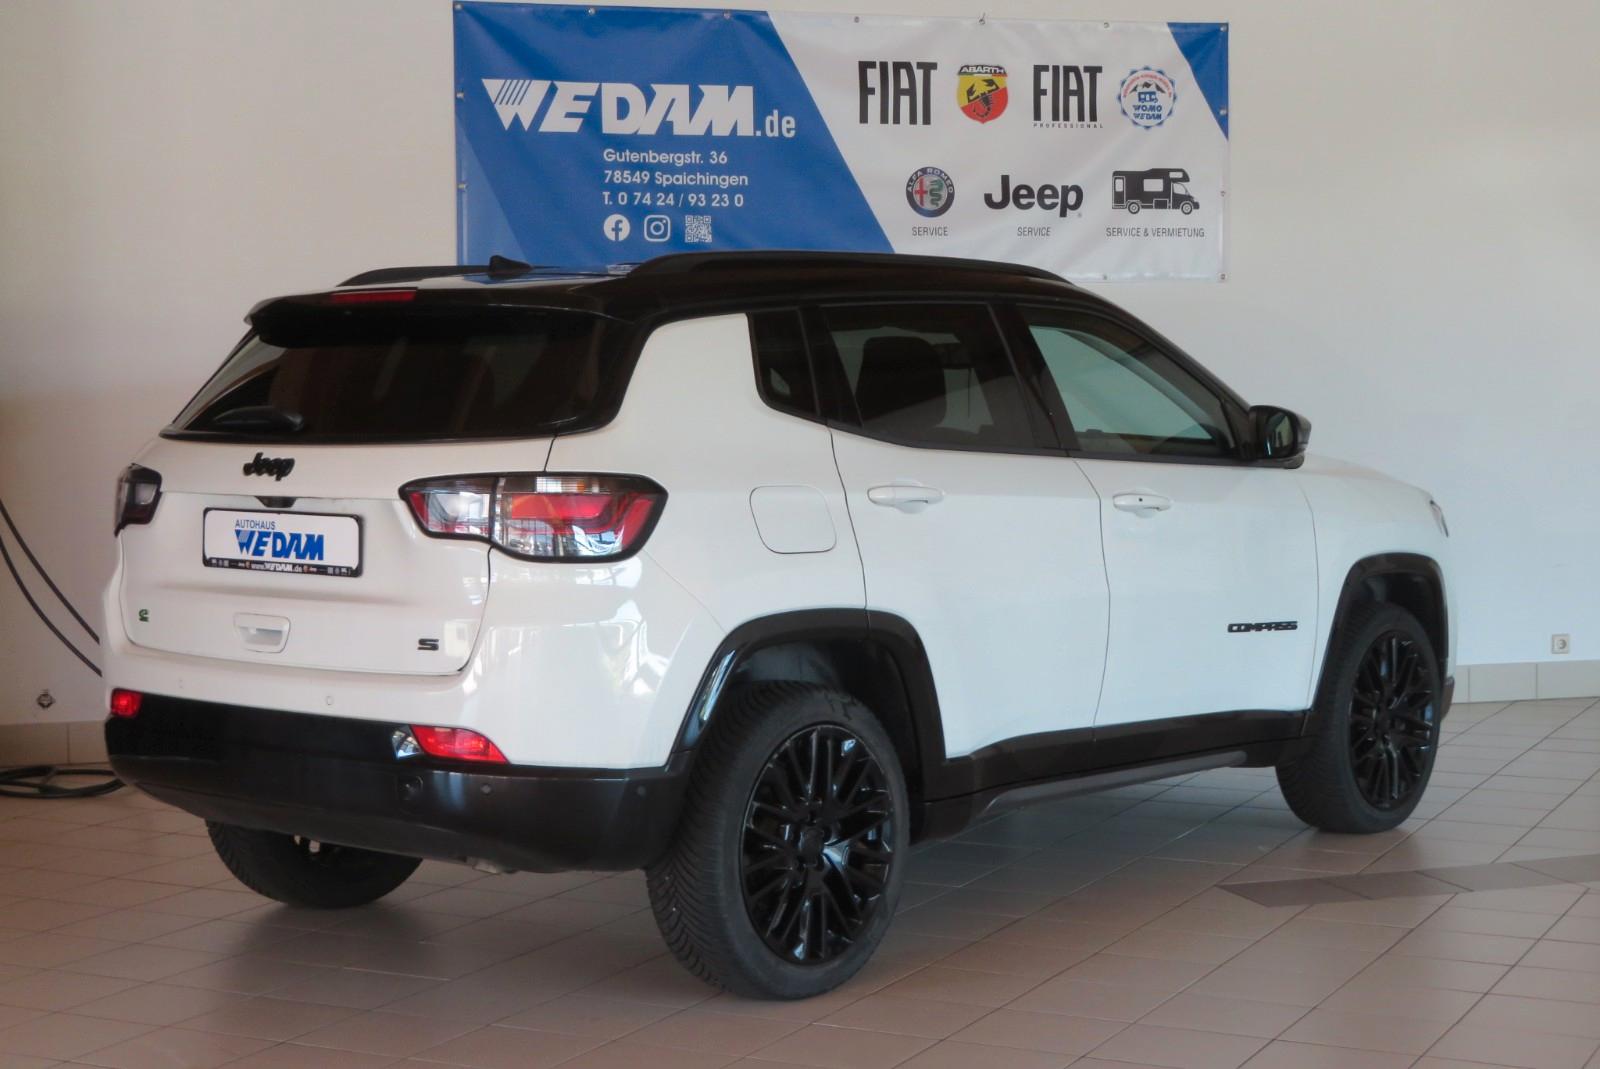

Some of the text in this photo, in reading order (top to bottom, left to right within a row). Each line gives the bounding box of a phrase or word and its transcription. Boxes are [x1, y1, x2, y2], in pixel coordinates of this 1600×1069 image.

[858, 61, 937, 125] FIAT
[1033, 65, 1102, 122] FIAT
[1133, 104, 1162, 112] WOMO
[603, 148, 728, 167] Gutenbergstr. 36
[604, 170, 749, 188] 78549 Spaichingen
[907, 168, 954, 193] ALFA ROMEO
[603, 191, 613, 205] T.
[618, 191, 628, 206] 0
[633, 192, 652, 206] 74
[656, 192, 675, 206] 24
[688, 193, 707, 207] 93
[711, 193, 730, 207] 23
[734, 194, 744, 207] 0
[984, 174, 1084, 218] Jeep
[911, 227, 949, 237] SERVICE
[1017, 227, 1051, 237] SERVICE
[1105, 227, 1205, 238] SERVICE & VERMIETUNG
[243, 452, 295, 482] Jeep
[235, 519, 276, 531] AUTOHAUS
[234, 529, 325, 561] WEDAM
[1228, 621, 1298, 632] COMPASS
[417, 638, 440, 651] S
